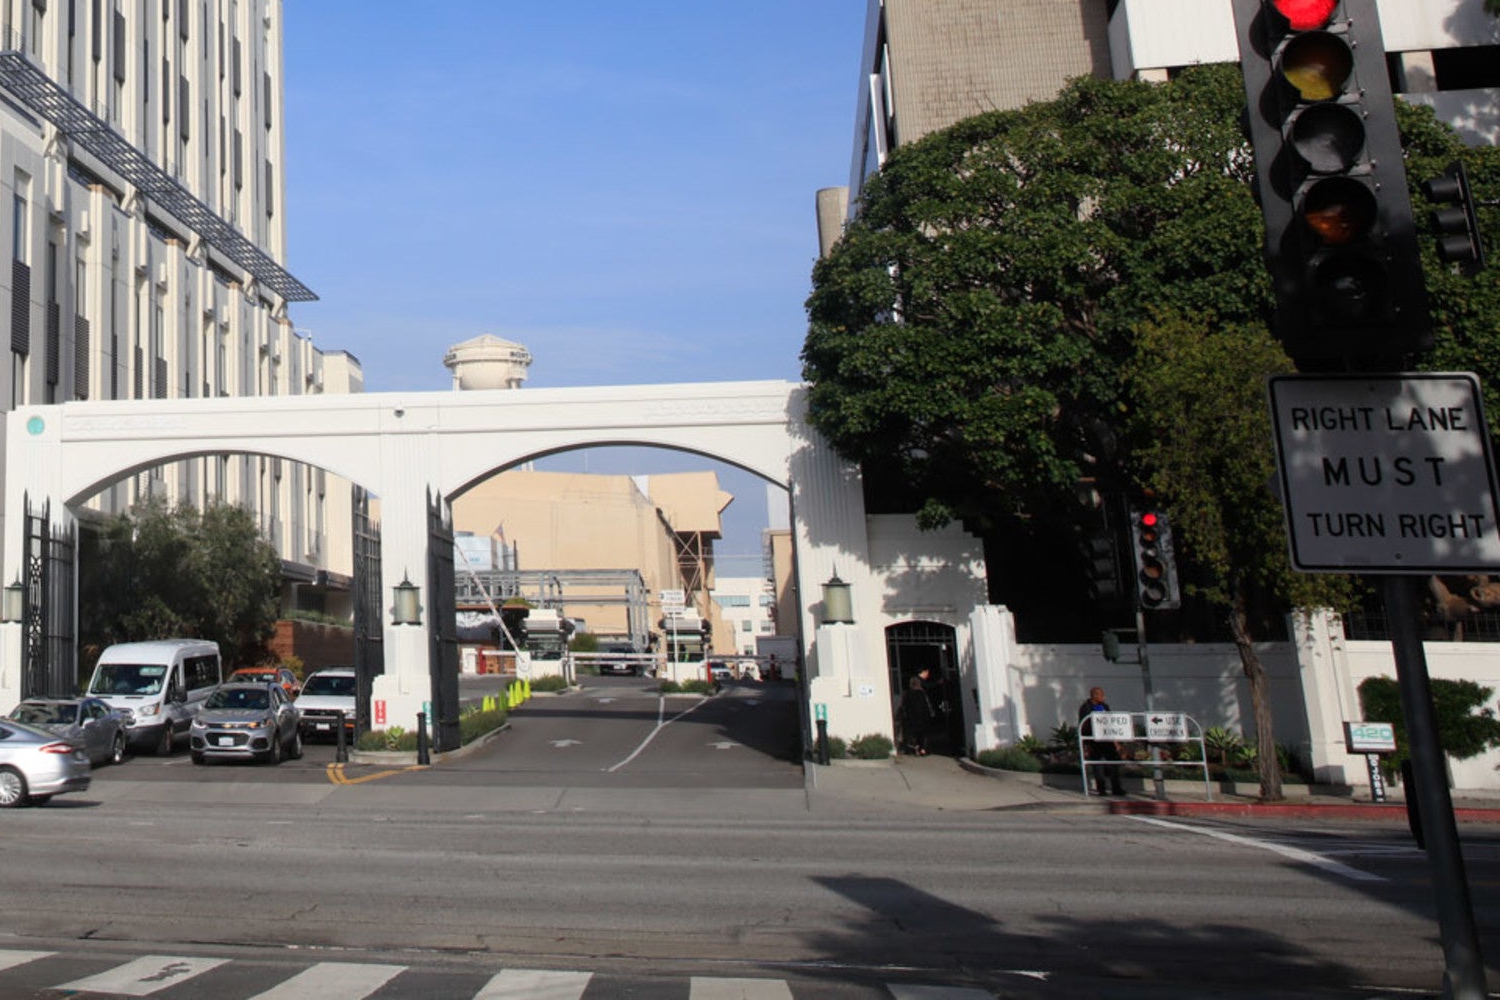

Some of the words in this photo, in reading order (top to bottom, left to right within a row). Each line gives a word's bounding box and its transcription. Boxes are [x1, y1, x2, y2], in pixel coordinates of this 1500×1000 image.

[1291, 407, 1374, 431] RIGHT
[1385, 407, 1468, 431] LANE
[1322, 457, 1445, 486] MUST
[1306, 513, 1386, 537] TURN
[1399, 514, 1485, 539] RIGHT
[1096, 716, 1109, 725] NO
[1110, 716, 1128, 725] PED
[1165, 716, 1182, 725] USE
